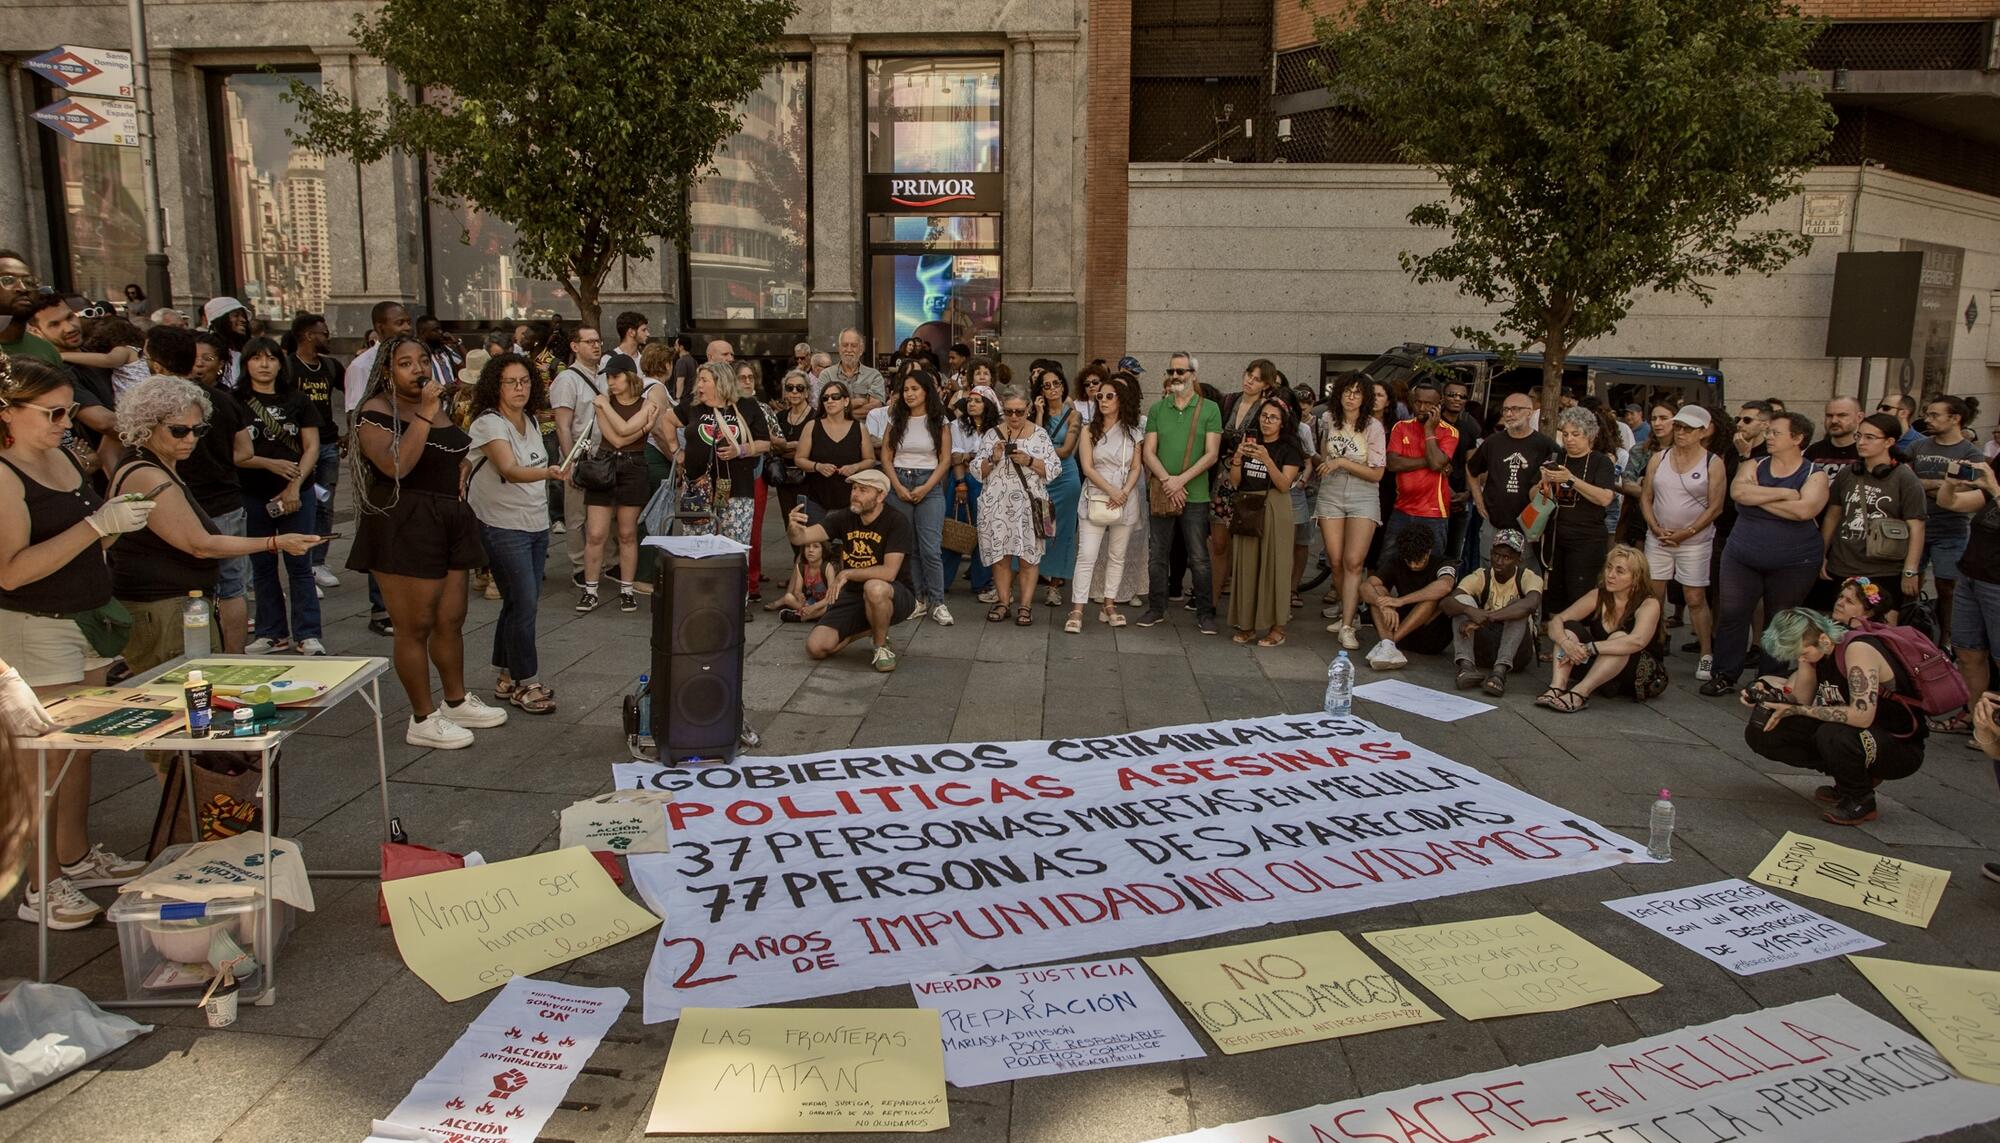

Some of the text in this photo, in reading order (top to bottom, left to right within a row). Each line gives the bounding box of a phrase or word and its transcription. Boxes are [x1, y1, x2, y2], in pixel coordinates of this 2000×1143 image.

[29, 61, 52, 69] Metro
[94, 59, 130, 69] Domingo
[105, 52, 129, 60] Santo
[122, 87, 130, 95] 2
[36, 113, 59, 121] Metro
[107, 109, 135, 118] España
[891, 179, 976, 196] PRIMOR
[666, 742, 1411, 830] POLITICAS ASESINAS
[596, 825, 640, 833] ACCIÓN
[671, 766, 1480, 877] 37 PERSONAS MUERTAS EN MELILLA
[1766, 841, 1817, 887] EL ESTADO
[1815, 861, 1862, 888] NO
[686, 875, 768, 923] 77
[781, 847, 1107, 908] PERSONAS
[408, 869, 582, 936] Ningún ser
[663, 937, 737, 988] 2
[728, 930, 832, 965] AÑOS
[853, 883, 1185, 954] IMPUNIDAD
[1265, 819, 1635, 893] OLVIDAMOS!
[1627, 885, 1768, 920] LAS FRONTERAS
[1862, 891, 1899, 909] TE
[1666, 900, 1791, 936] SON UN ARMA
[478, 911, 576, 953] humano
[1375, 923, 1538, 957] REPÚBLICA
[478, 918, 642, 984] es ilegal
[793, 952, 840, 973] DE
[1704, 944, 1737, 956] DE
[915, 962, 1135, 996] VERDAD JUSTICIA
[1219, 953, 1307, 991] NO
[1423, 955, 1581, 987] DEL CONGO
[1020, 988, 1036, 1003] Y
[1481, 974, 1609, 1011] LIBRE
[525, 998, 596, 1015] OLVIDAMOS
[539, 1009, 570, 1023] NO
[941, 990, 1138, 1033] REPARACIÓN
[701, 1027, 751, 1047] LAS
[940, 1024, 1076, 1052] MARLASKA DIMISIÓN
[1065, 1029, 1167, 1050] RESPONSABLE
[479, 1052, 565, 1071] ANTIRRACISTA
[501, 1045, 563, 1061] ACCIÓN
[1576, 1086, 1631, 1114] EN
[1608, 1018, 1861, 1101] MELILLA
[714, 1056, 885, 1094] MATAN
[1756, 1041, 1960, 1121] REPARACIÓN
[440, 1117, 509, 1135] ACCIÓN
[855, 1118, 929, 1127] NO OLVIDAMOS
